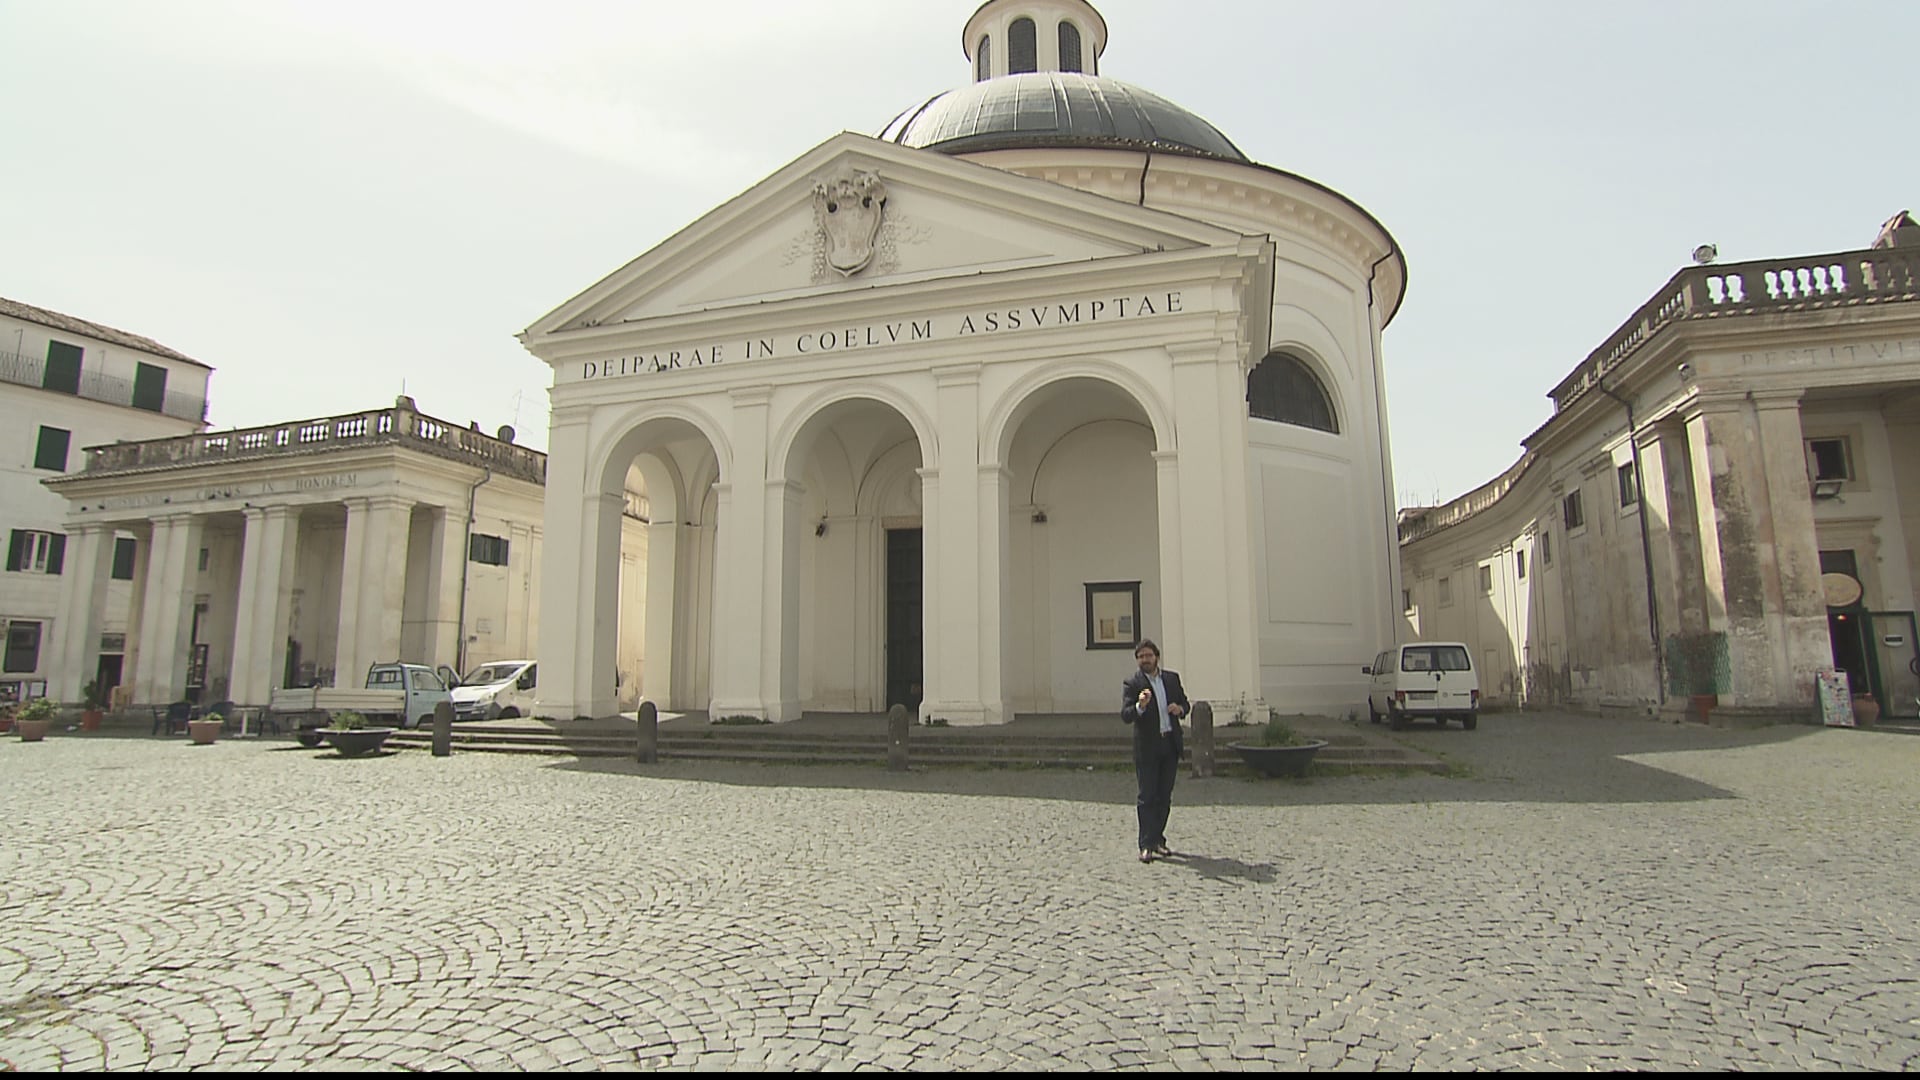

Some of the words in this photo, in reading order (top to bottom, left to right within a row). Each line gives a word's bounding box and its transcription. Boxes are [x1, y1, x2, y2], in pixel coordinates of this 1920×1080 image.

[583, 344, 723, 380] DEIPARAE
[745, 338, 775, 359] IN
[797, 319, 932, 353] COELVM
[959, 291, 1184, 336] ASSVMPTAE
[295, 473, 358, 491] HONOREM
